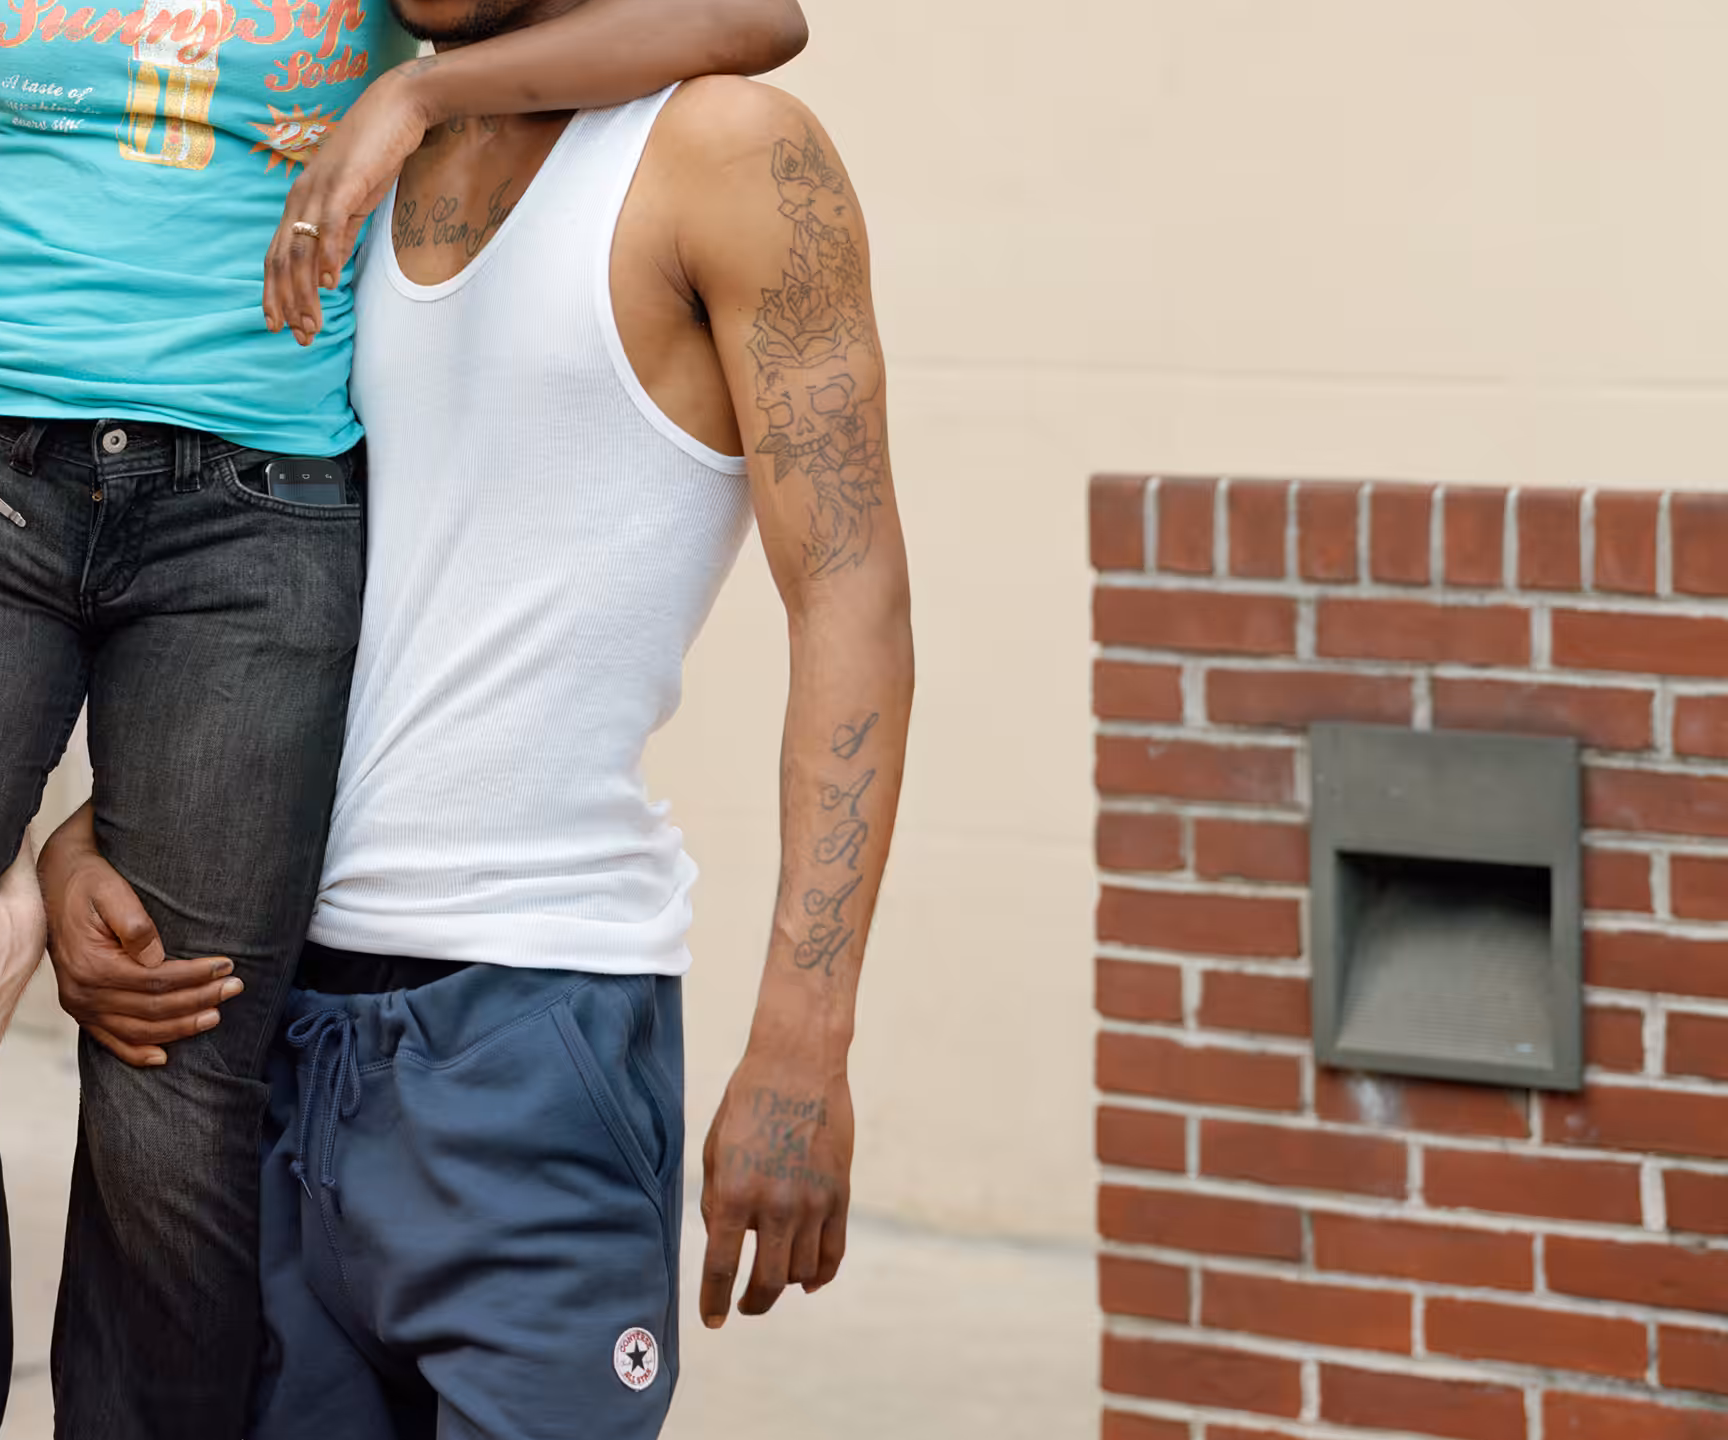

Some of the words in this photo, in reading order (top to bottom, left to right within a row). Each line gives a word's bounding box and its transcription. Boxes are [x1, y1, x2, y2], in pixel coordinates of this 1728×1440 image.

[264, 44, 369, 92] Soda
[1, 74, 20, 89] A
[22, 79, 63, 97] taste
[67, 87, 93, 104] of
